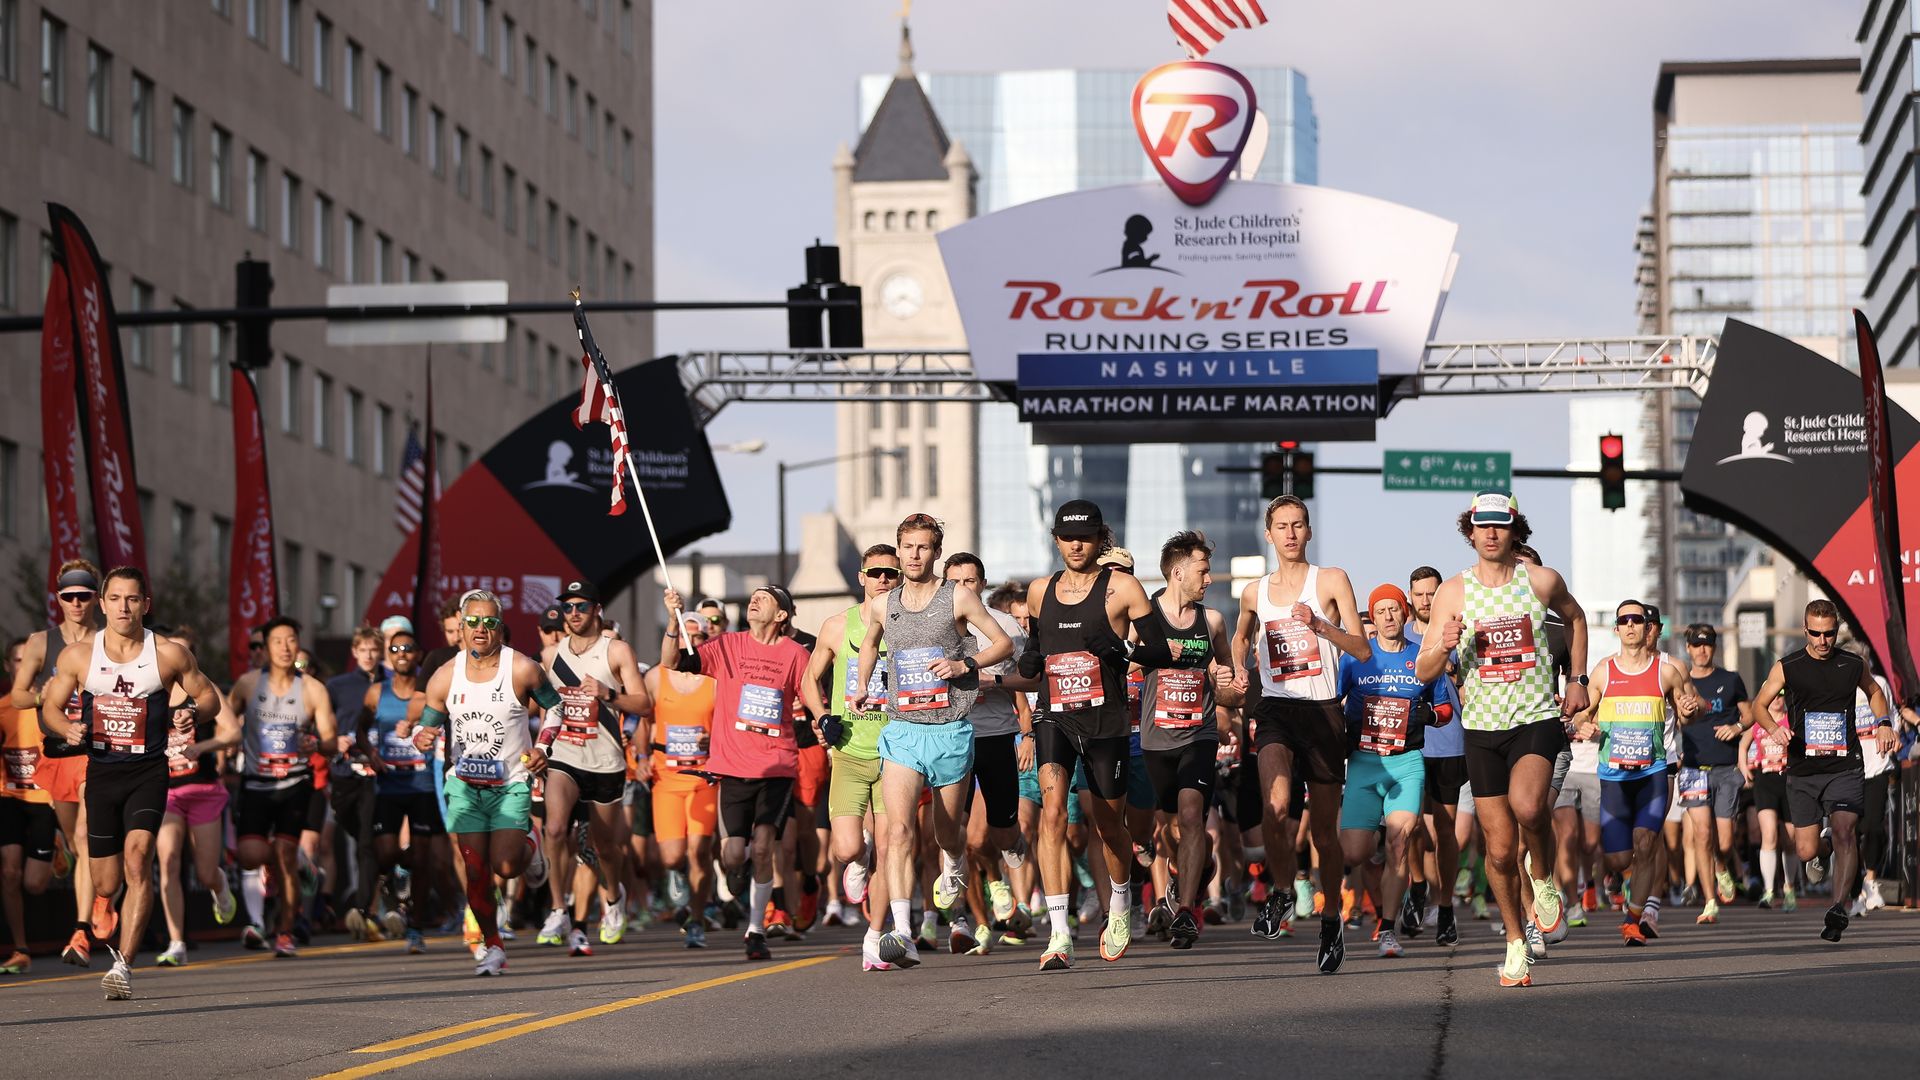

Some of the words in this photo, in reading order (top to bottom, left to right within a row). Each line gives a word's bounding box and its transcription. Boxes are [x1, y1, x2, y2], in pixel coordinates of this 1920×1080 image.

[1173, 216, 1193, 231] St.
[1194, 214, 1227, 232] Jude
[1228, 212, 1301, 230] Children's
[1173, 231, 1238, 248] Research
[1240, 229, 1301, 248] Hospital
[1004, 280, 1186, 321] Rock
[1242, 279, 1391, 321] Roll
[1045, 331, 1210, 352] RUNNING
[1220, 327, 1350, 350] SERIES
[1101, 360, 1306, 378] NASHVILLE
[1022, 396, 1153, 414] MARATHON
[1176, 395, 1237, 412] HALF
[1244, 393, 1377, 412] MARATHON
[1783, 416, 1800, 430] St.
[1800, 416, 1827, 431] Jude
[1828, 413, 1866, 430] Childr
[1783, 428, 1837, 446] Research
[1838, 428, 1867, 445] Hosp
[1452, 461, 1478, 473] Ave
[1485, 457, 1497, 473] S
[1430, 476, 1466, 488] Parks
[1062, 513, 1090, 523] BANDIT
[1485, 628, 1523, 644] 1023
[1275, 640, 1308, 655] 1030
[1056, 675, 1092, 690] 1020
[1163, 690, 1197, 703] 14169
[564, 706, 590, 718] 1024
[742, 703, 779, 719] 23323
[1615, 702, 1652, 715] RYAN
[1711, 698, 1723, 711] 23
[849, 712, 882, 721] THURSDAY
[1367, 715, 1403, 729] 13437
[103, 718, 136, 733] 1022
[466, 731, 489, 743] ALMA
[1809, 730, 1843, 741] 20136
[668, 743, 698, 753] 2003
[1612, 745, 1650, 756] 20045
[461, 762, 497, 774] 20114
